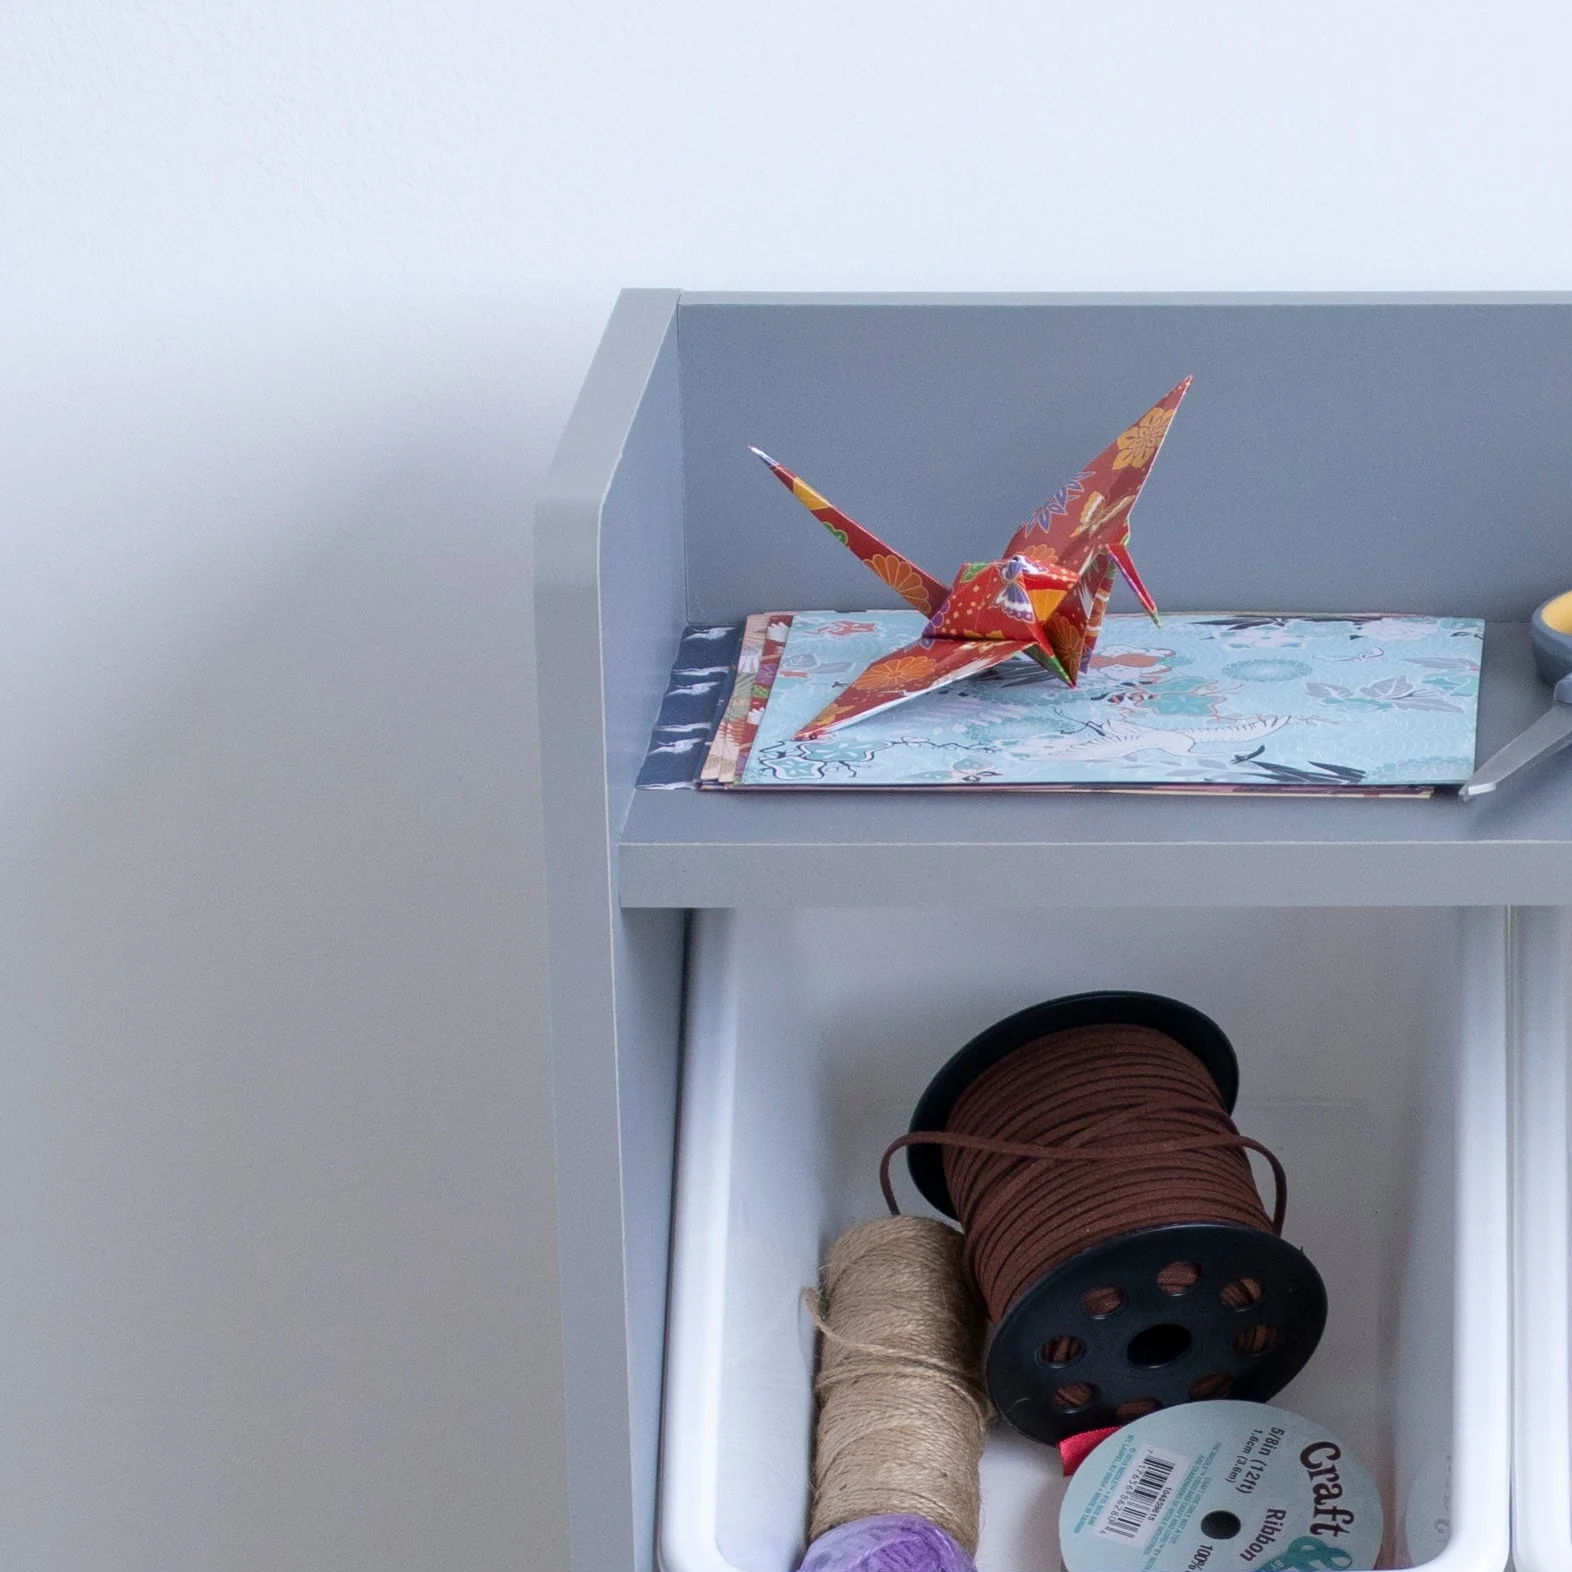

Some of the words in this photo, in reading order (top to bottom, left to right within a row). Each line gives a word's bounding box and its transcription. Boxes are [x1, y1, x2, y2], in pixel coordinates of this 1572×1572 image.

[1258, 1426, 1285, 1456] 5/8in
[1235, 1459, 1267, 1494] (12ft)
[1300, 1441, 1354, 1537] Craft
[1239, 1509, 1287, 1562] Ribbon
[1188, 1544, 1214, 1570] 100%
